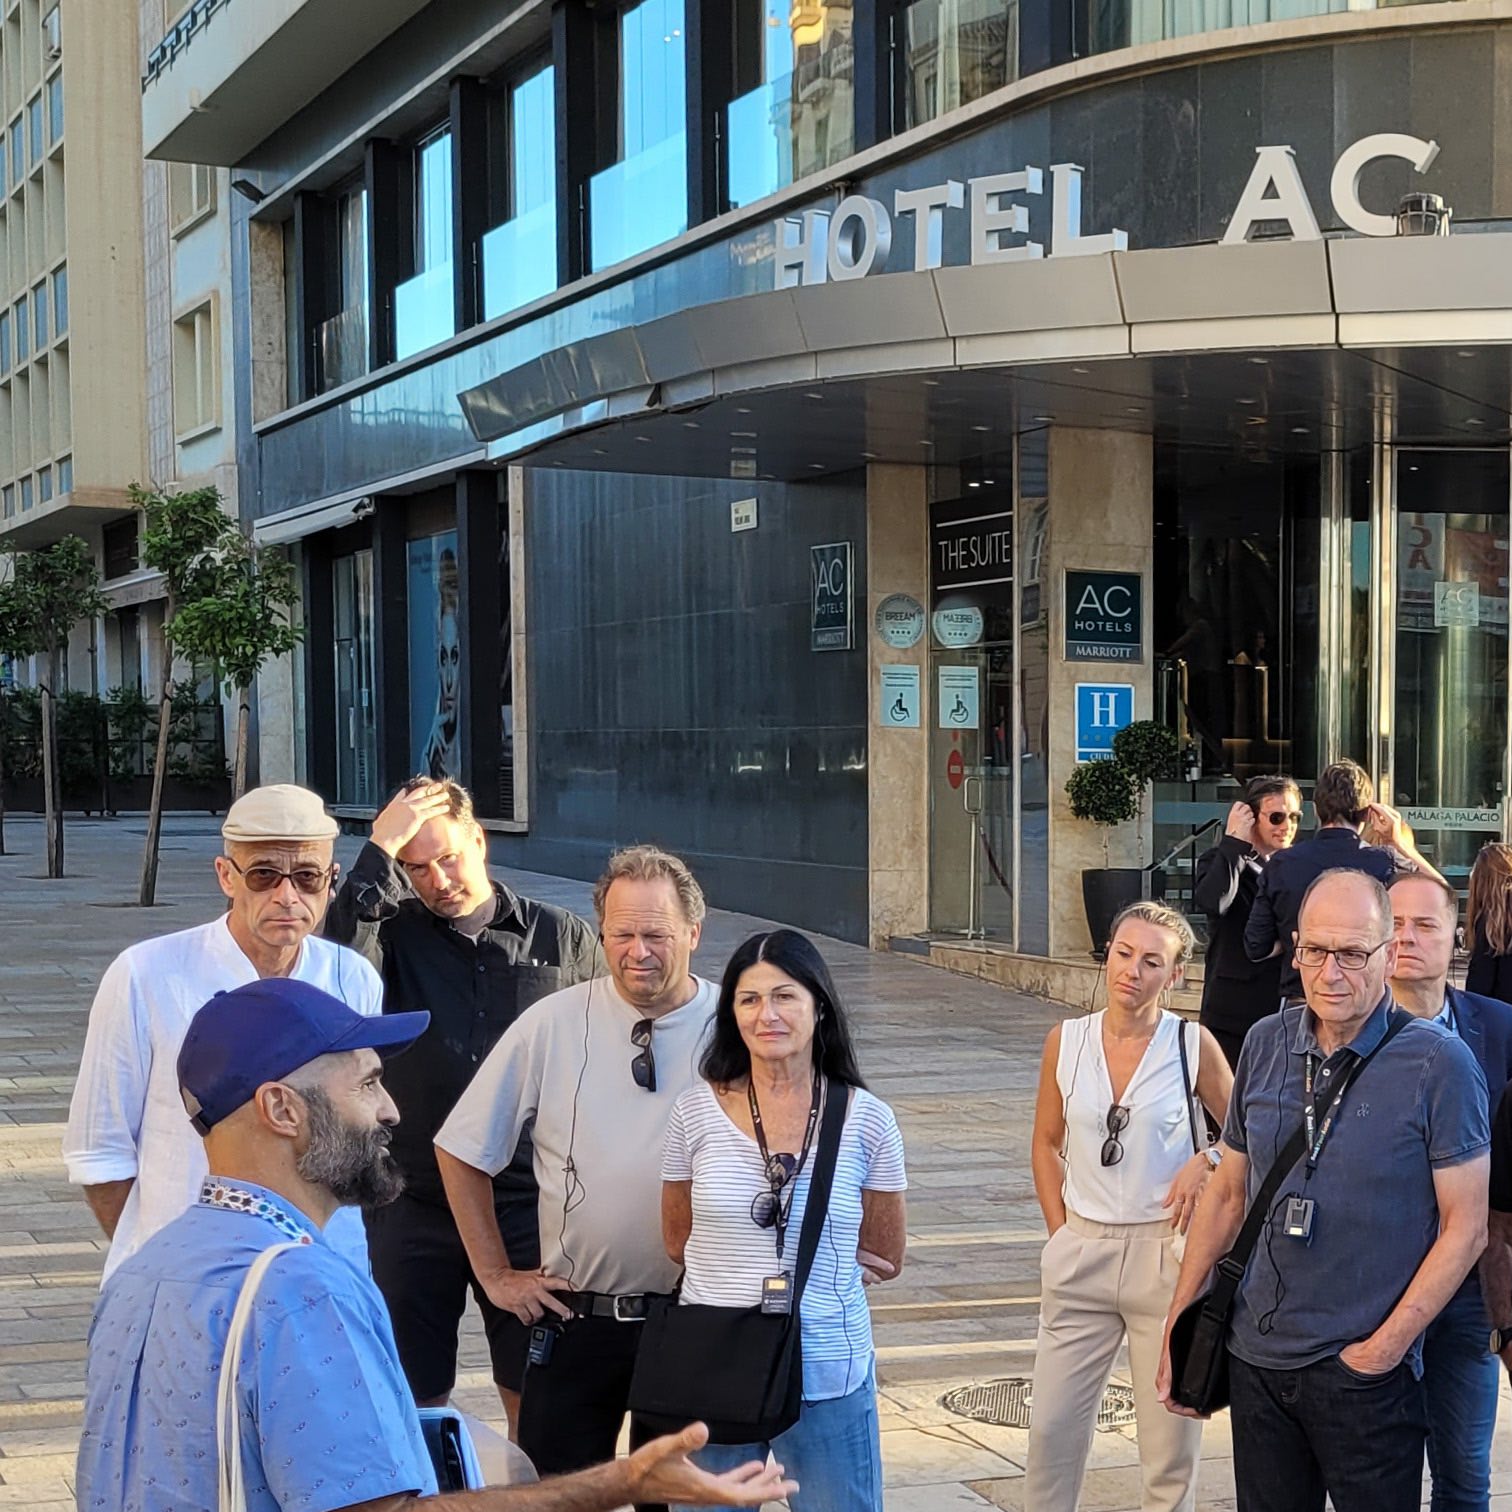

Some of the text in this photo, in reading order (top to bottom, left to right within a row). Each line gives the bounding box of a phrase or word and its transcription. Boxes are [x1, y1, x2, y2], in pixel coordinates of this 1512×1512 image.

[774, 162, 1129, 291] HOTEL
[1218, 132, 1441, 246] AC
[816, 558, 844, 597] AC
[1075, 584, 1132, 618] AC
[816, 602, 844, 616] HOTELS
[885, 611, 916, 622] BREEAM
[1075, 620, 1132, 633] HOTELS
[1076, 645, 1132, 658] MARRIOTT
[1090, 691, 1119, 728] H
[1455, 812, 1500, 823] PALACIO
